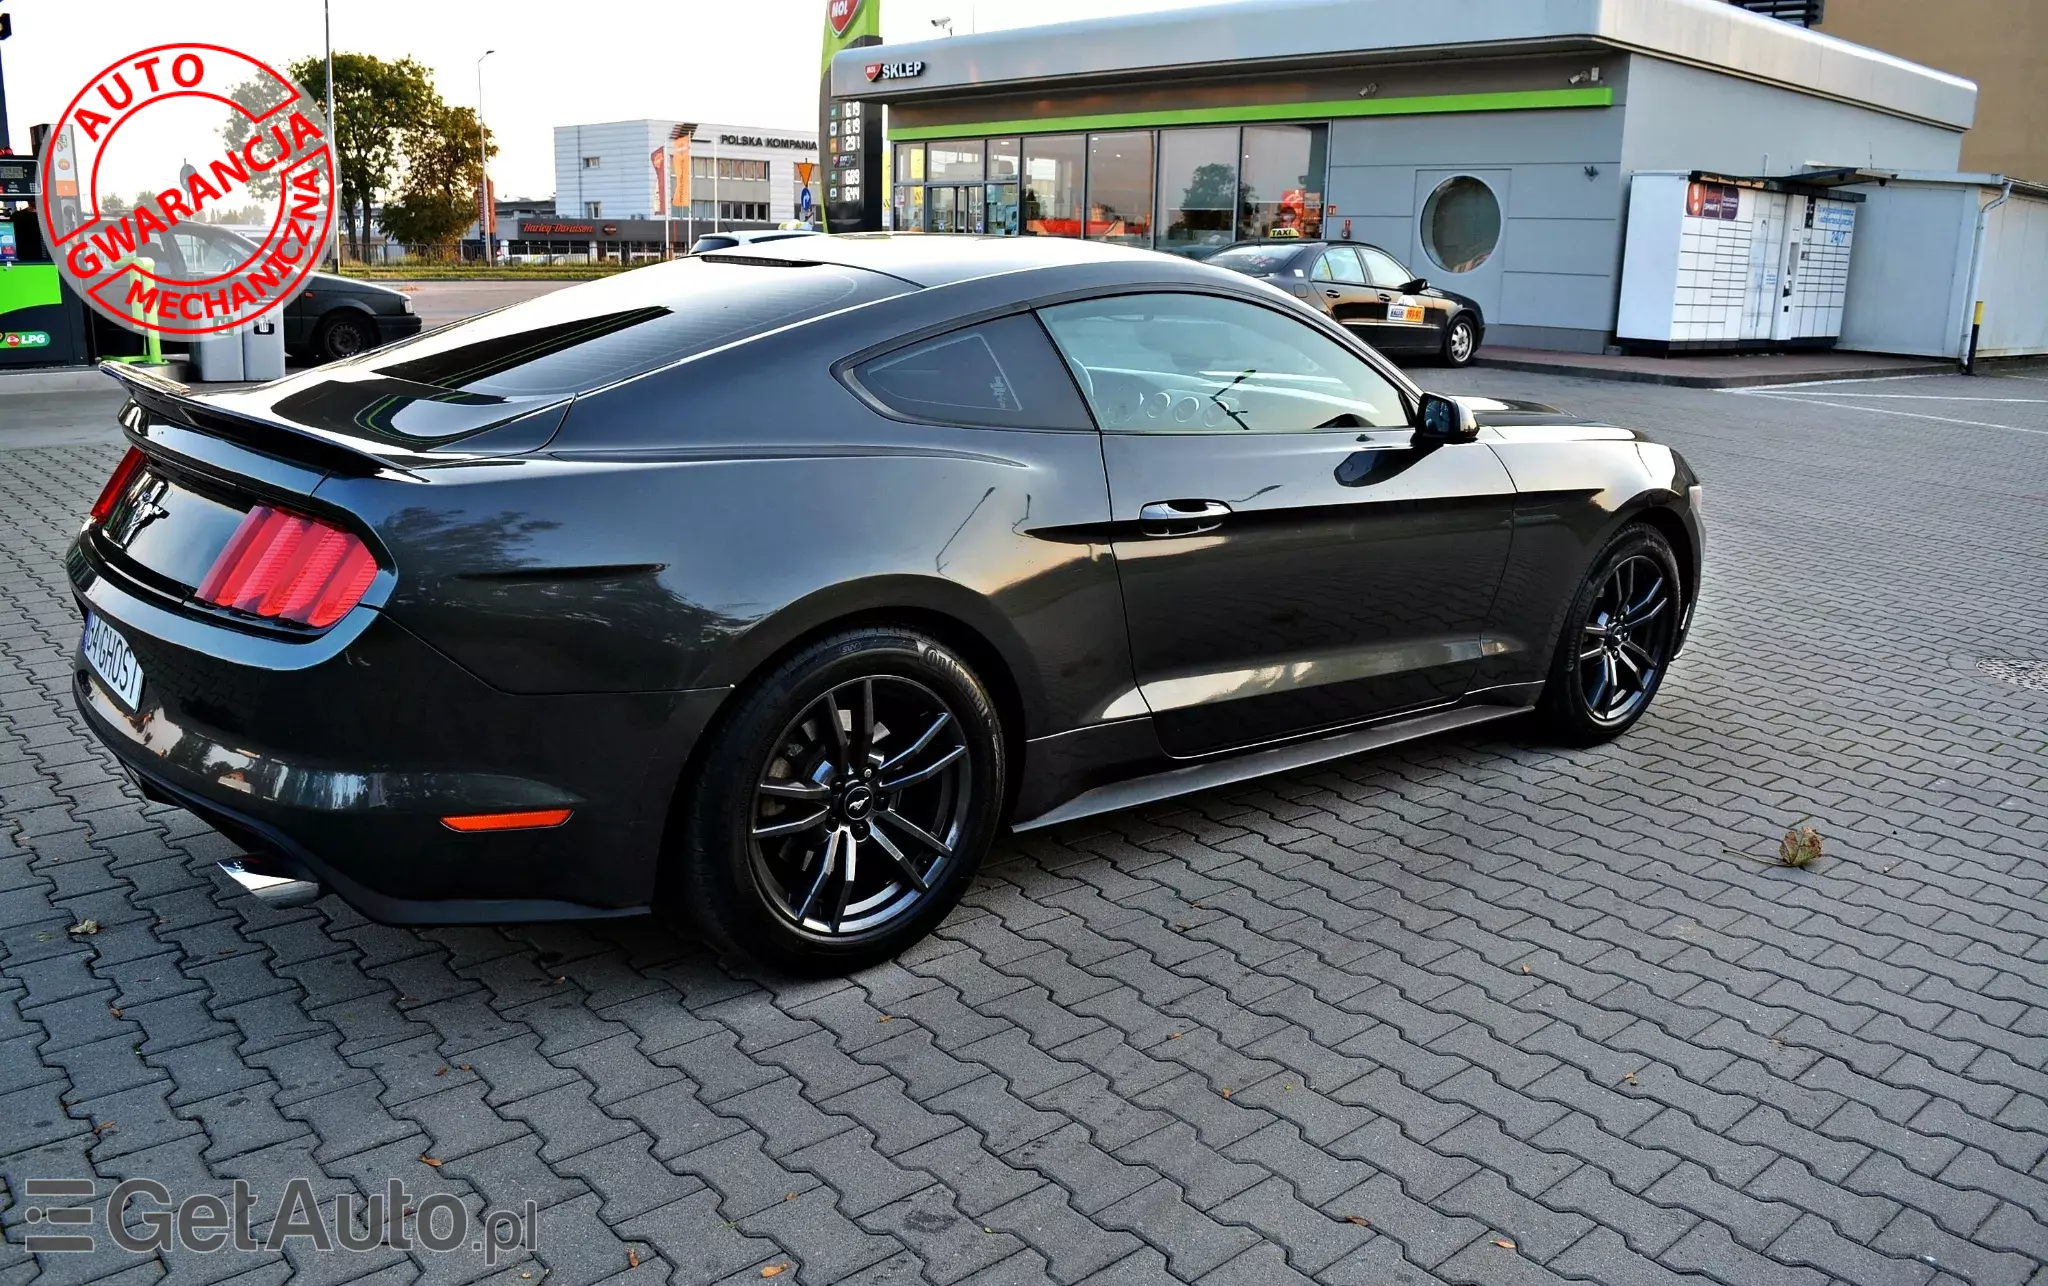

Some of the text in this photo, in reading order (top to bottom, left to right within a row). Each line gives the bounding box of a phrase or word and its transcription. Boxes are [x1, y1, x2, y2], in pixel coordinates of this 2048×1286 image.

[832, 2, 848, 18] MOL
[882, 61, 922, 79] SKLEP
[721, 134, 818, 151] POLSKA KOMPANIA
[521, 222, 594, 235] Harley-Davidson
[21, 334, 46, 344] LPG
